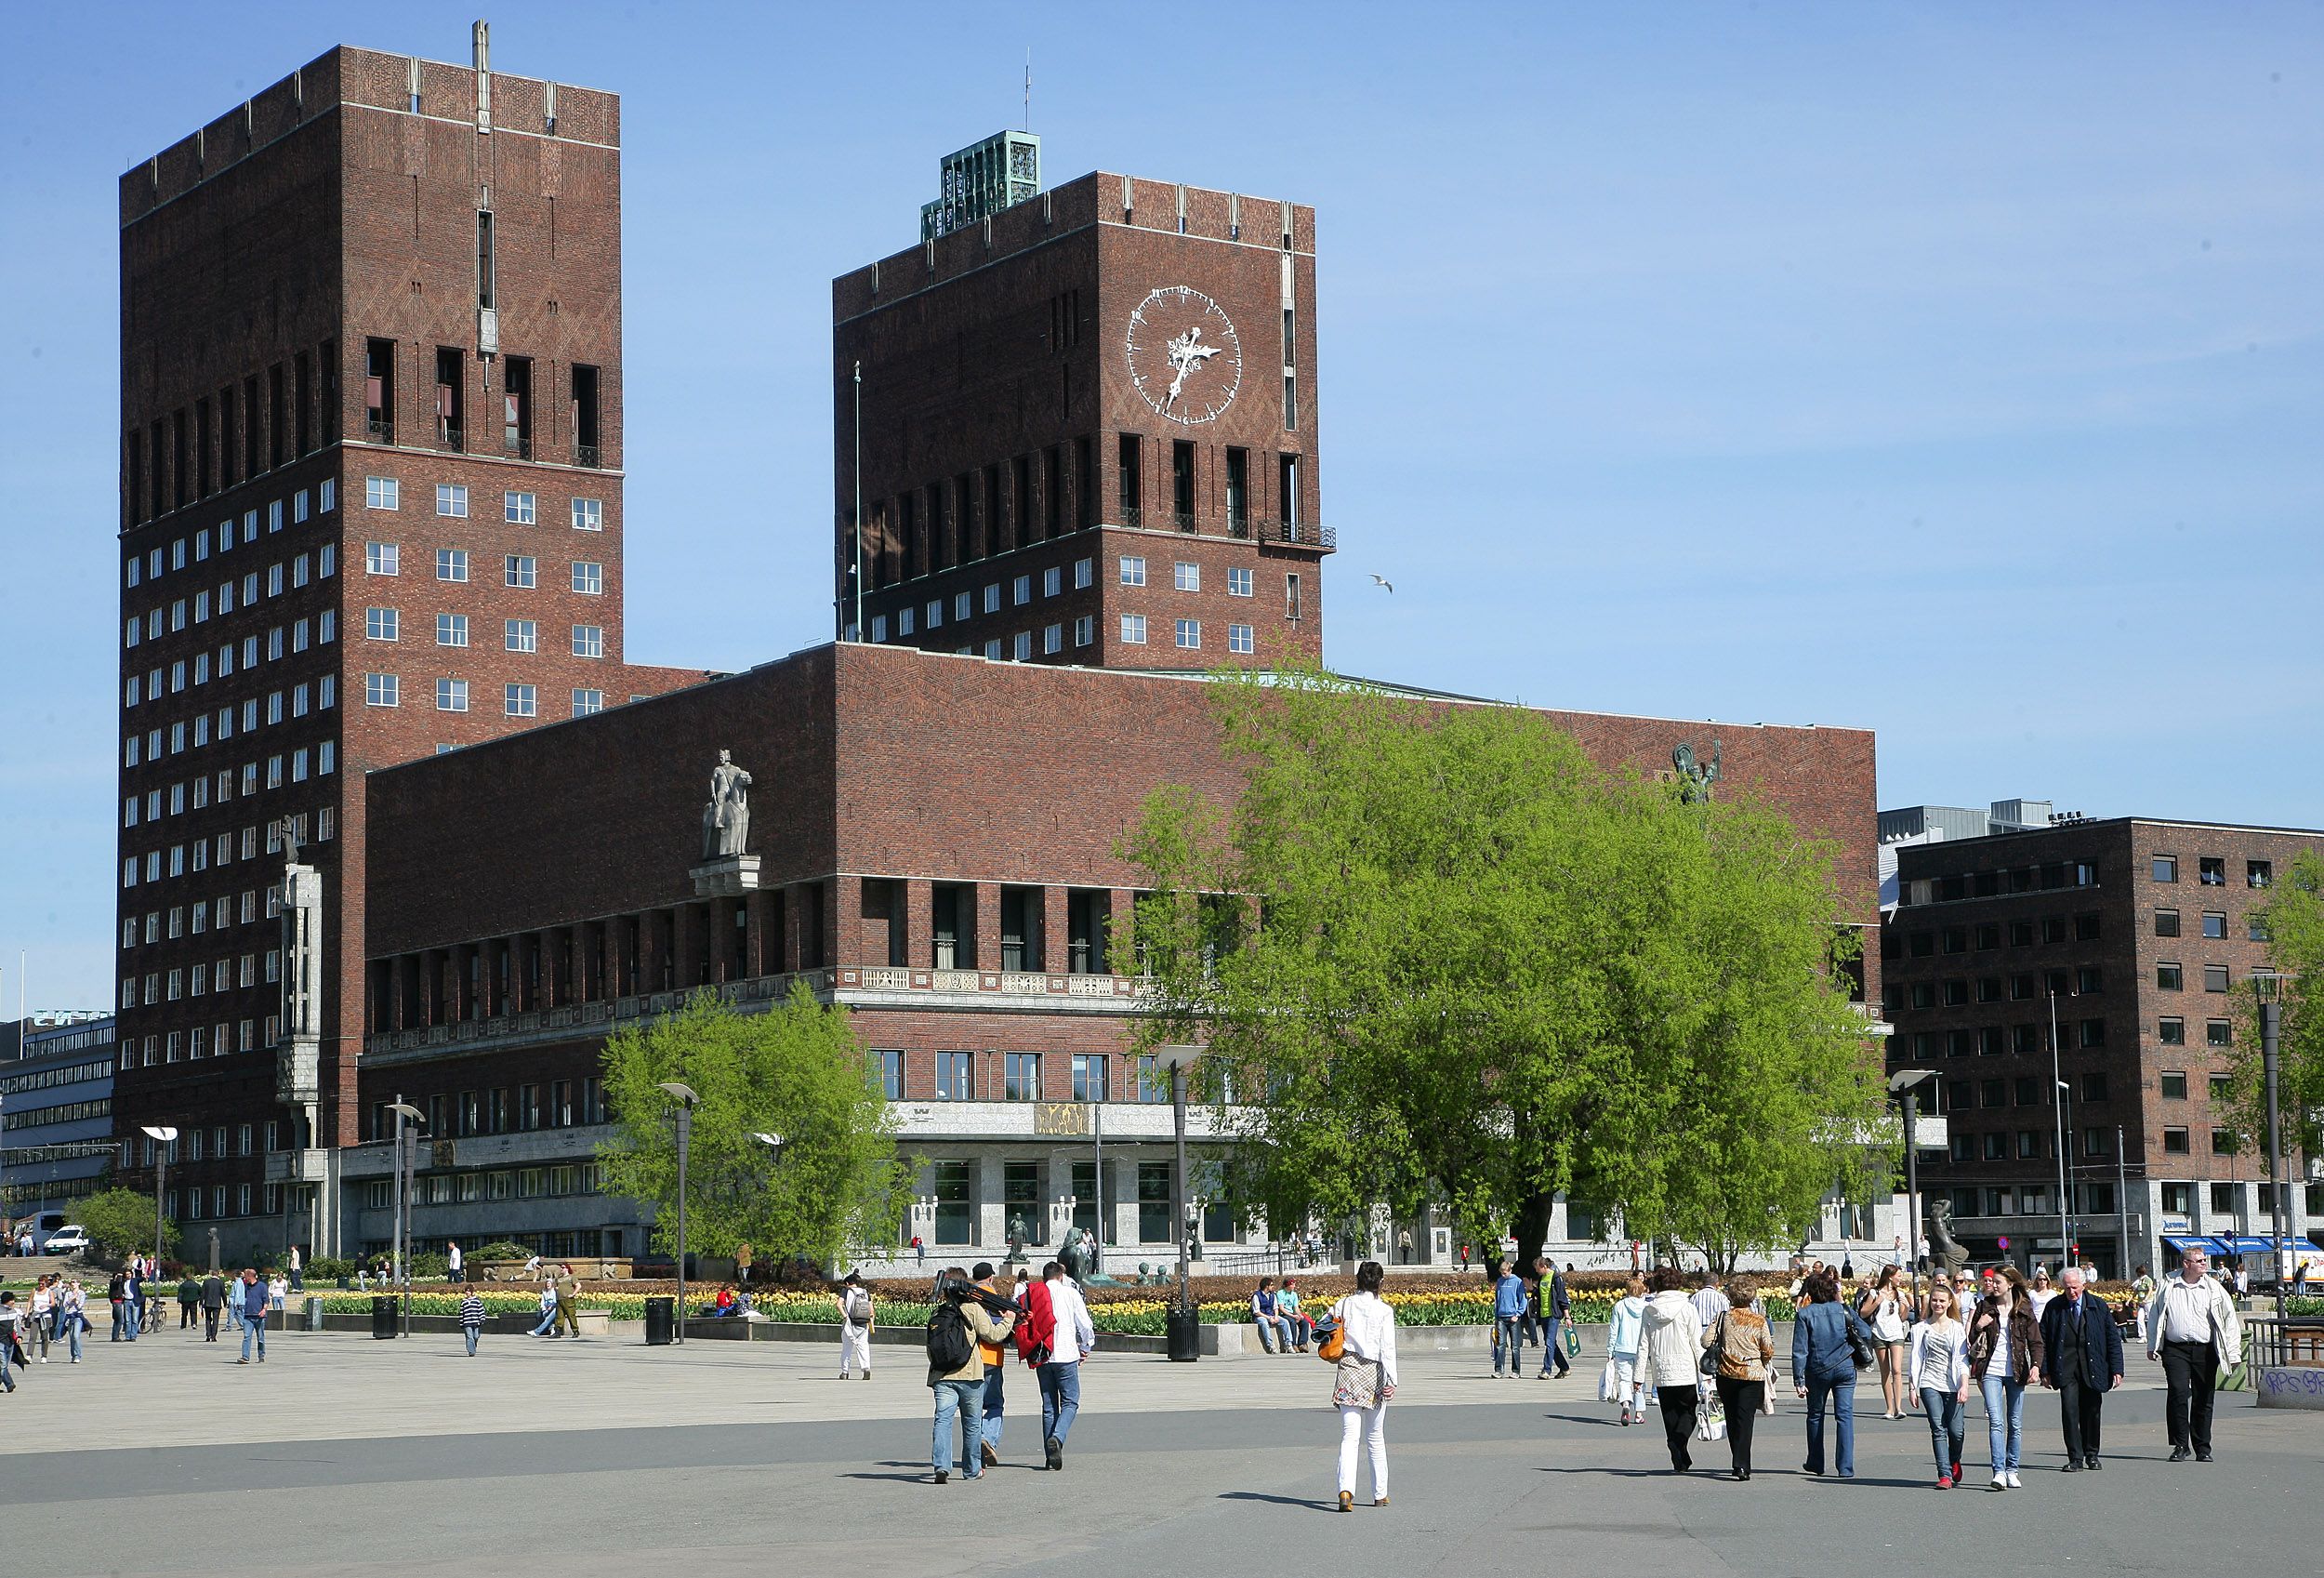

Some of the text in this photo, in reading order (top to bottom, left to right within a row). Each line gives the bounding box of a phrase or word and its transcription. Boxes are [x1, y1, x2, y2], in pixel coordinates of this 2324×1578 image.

[1152, 288, 1160, 298] 11
[1180, 285, 1189, 295] 12
[1209, 298, 1214, 308] 1
[1130, 310, 1142, 320] 10
[1228, 325, 1235, 334] 2
[1126, 342, 1133, 351] 9
[1235, 357, 1242, 367] 3
[1133, 377, 1141, 386] 8
[1228, 390, 1235, 399] 4
[1182, 416, 1189, 425] 6
[1209, 411, 1216, 421] 5
